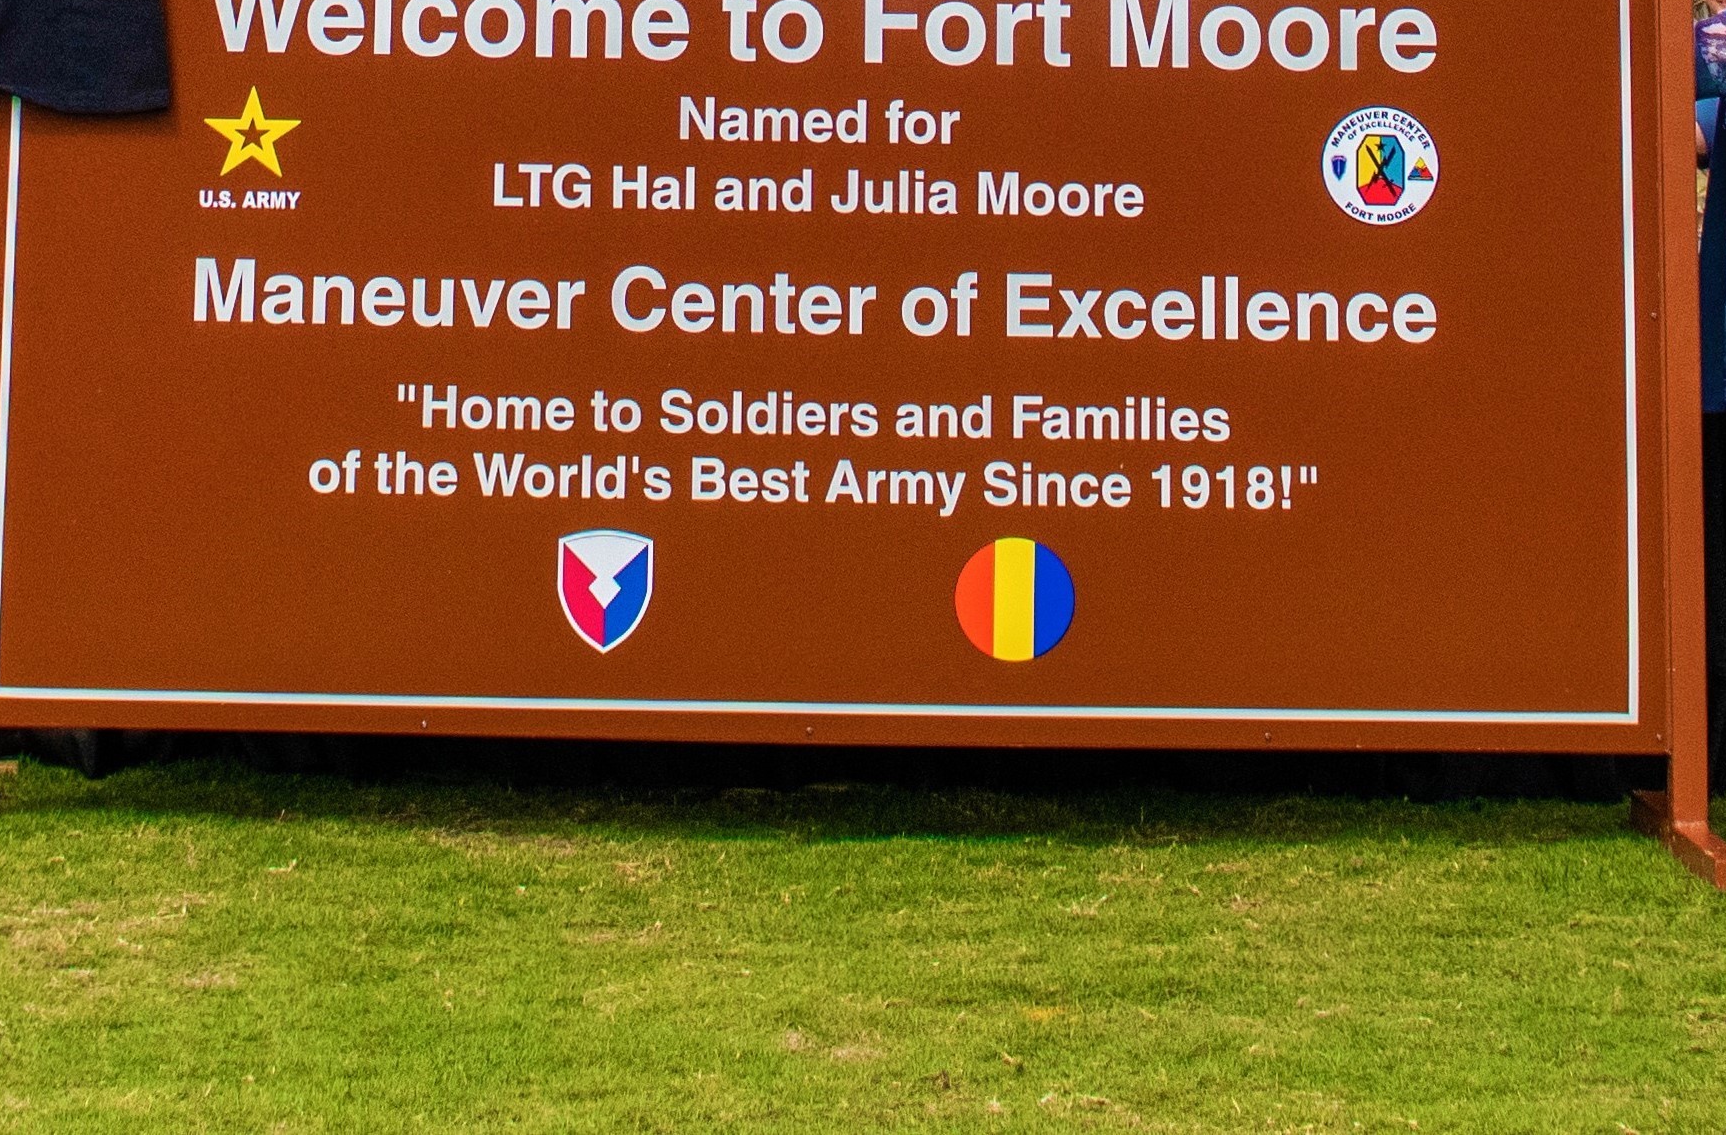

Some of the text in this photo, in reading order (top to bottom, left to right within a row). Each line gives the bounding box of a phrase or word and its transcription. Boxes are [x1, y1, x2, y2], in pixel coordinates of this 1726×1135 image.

[679, 95, 961, 145] Named for
[1331, 110, 1431, 149] MANEUVER CENTER
[1347, 120, 1415, 142] OF EXCELLENCE
[199, 189, 302, 210] U.S. ARMY
[493, 162, 1145, 218] LTG Hal and Julia Moore
[1344, 201, 1416, 222] FORT MOORE
[193, 257, 1437, 344] Maneuver Center of Excellence
[397, 383, 1231, 442] "Home to Soldiers and Families
[308, 448, 1318, 517] of the World's Best Army Since 1918!"
